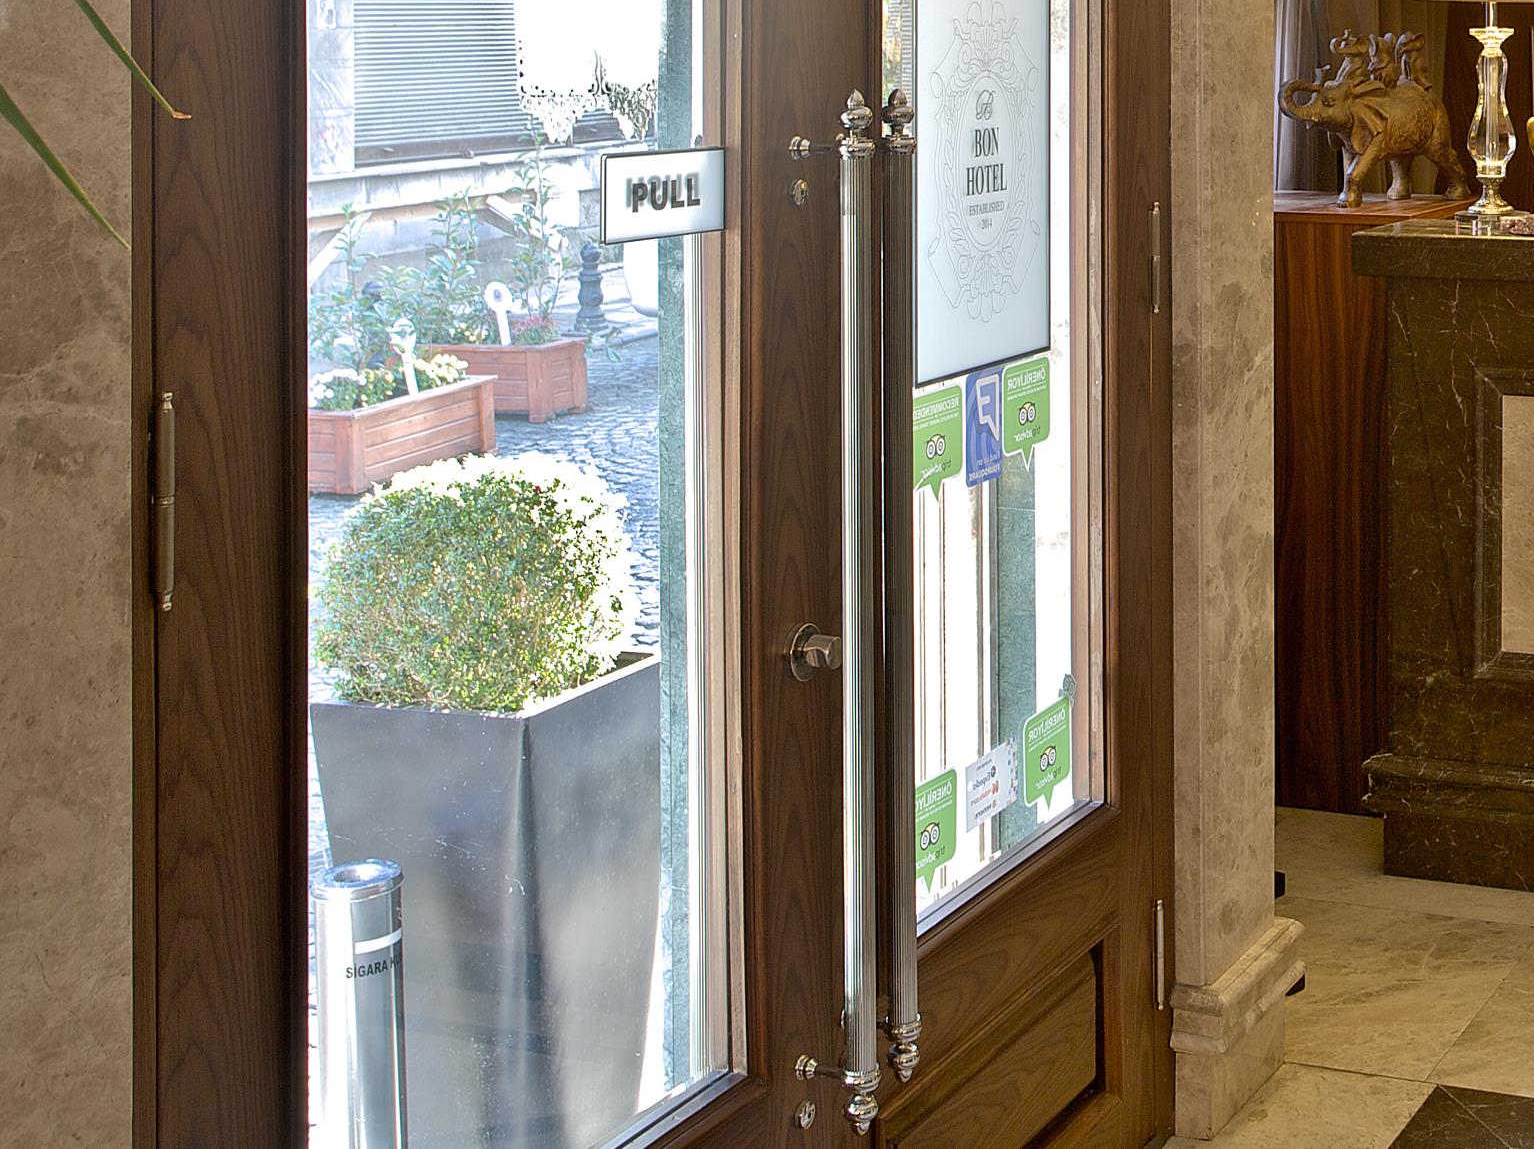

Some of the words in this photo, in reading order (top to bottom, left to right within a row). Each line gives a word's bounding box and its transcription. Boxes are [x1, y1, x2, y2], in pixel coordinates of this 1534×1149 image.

[974, 127, 999, 158] BON
[966, 163, 1008, 196] HOTEL
[632, 178, 700, 213] PULL
[969, 201, 1004, 216] ESTABLISHED
[346, 959, 388, 979] SİGARA
